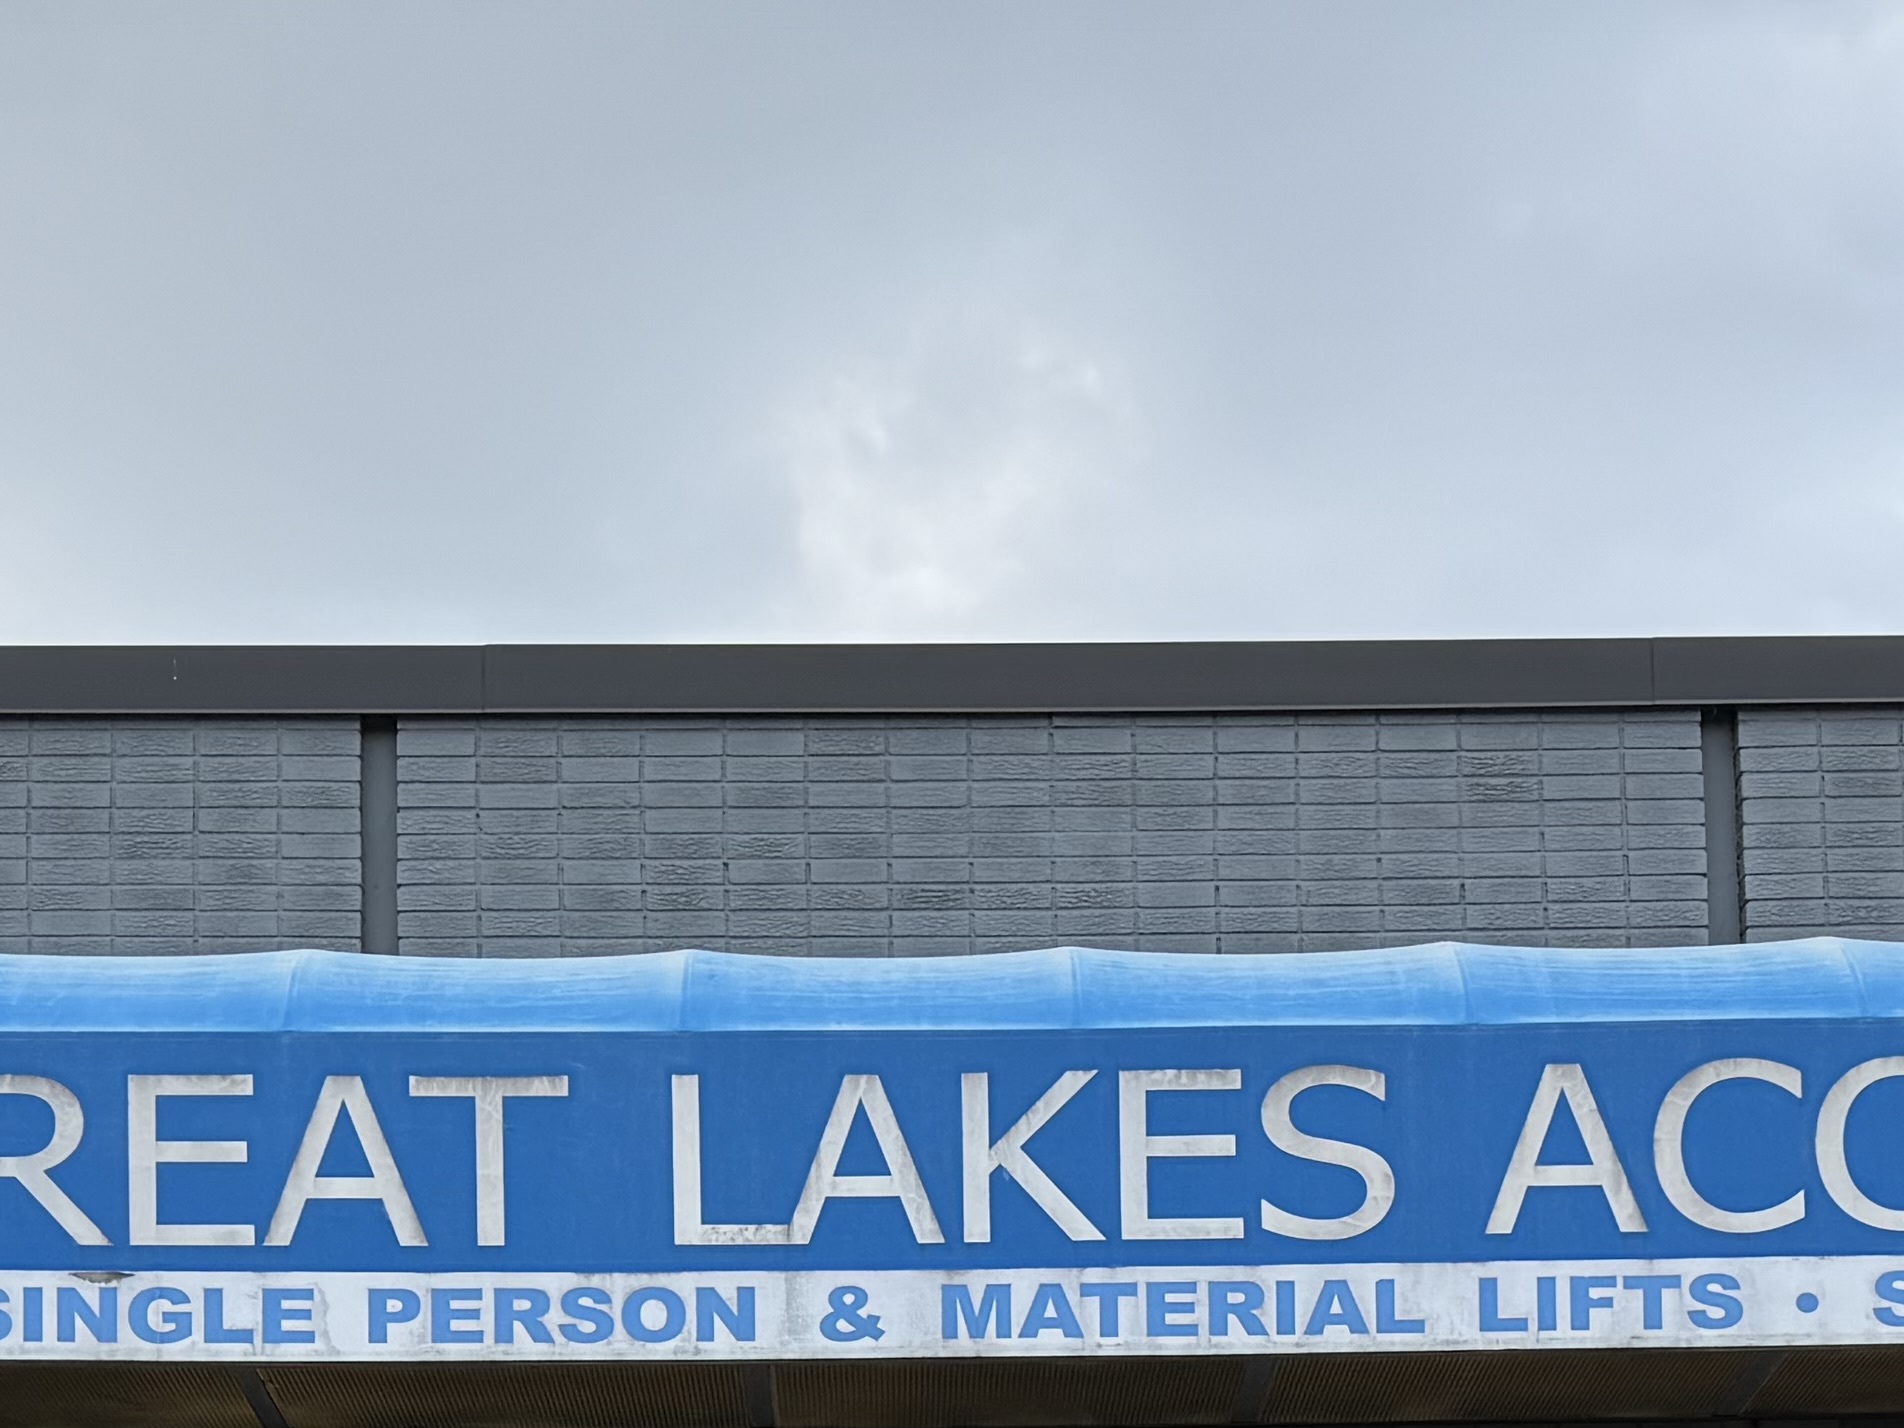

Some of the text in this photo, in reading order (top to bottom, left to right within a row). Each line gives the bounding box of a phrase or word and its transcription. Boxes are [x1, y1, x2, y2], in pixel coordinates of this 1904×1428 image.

[672, 1065, 1395, 1245] LAKES
[368, 1287, 756, 1344] PERSON
[820, 1286, 885, 1342] &
[941, 1279, 1425, 1340] MATERIAL
[1479, 1274, 1743, 1332] LIFTS
